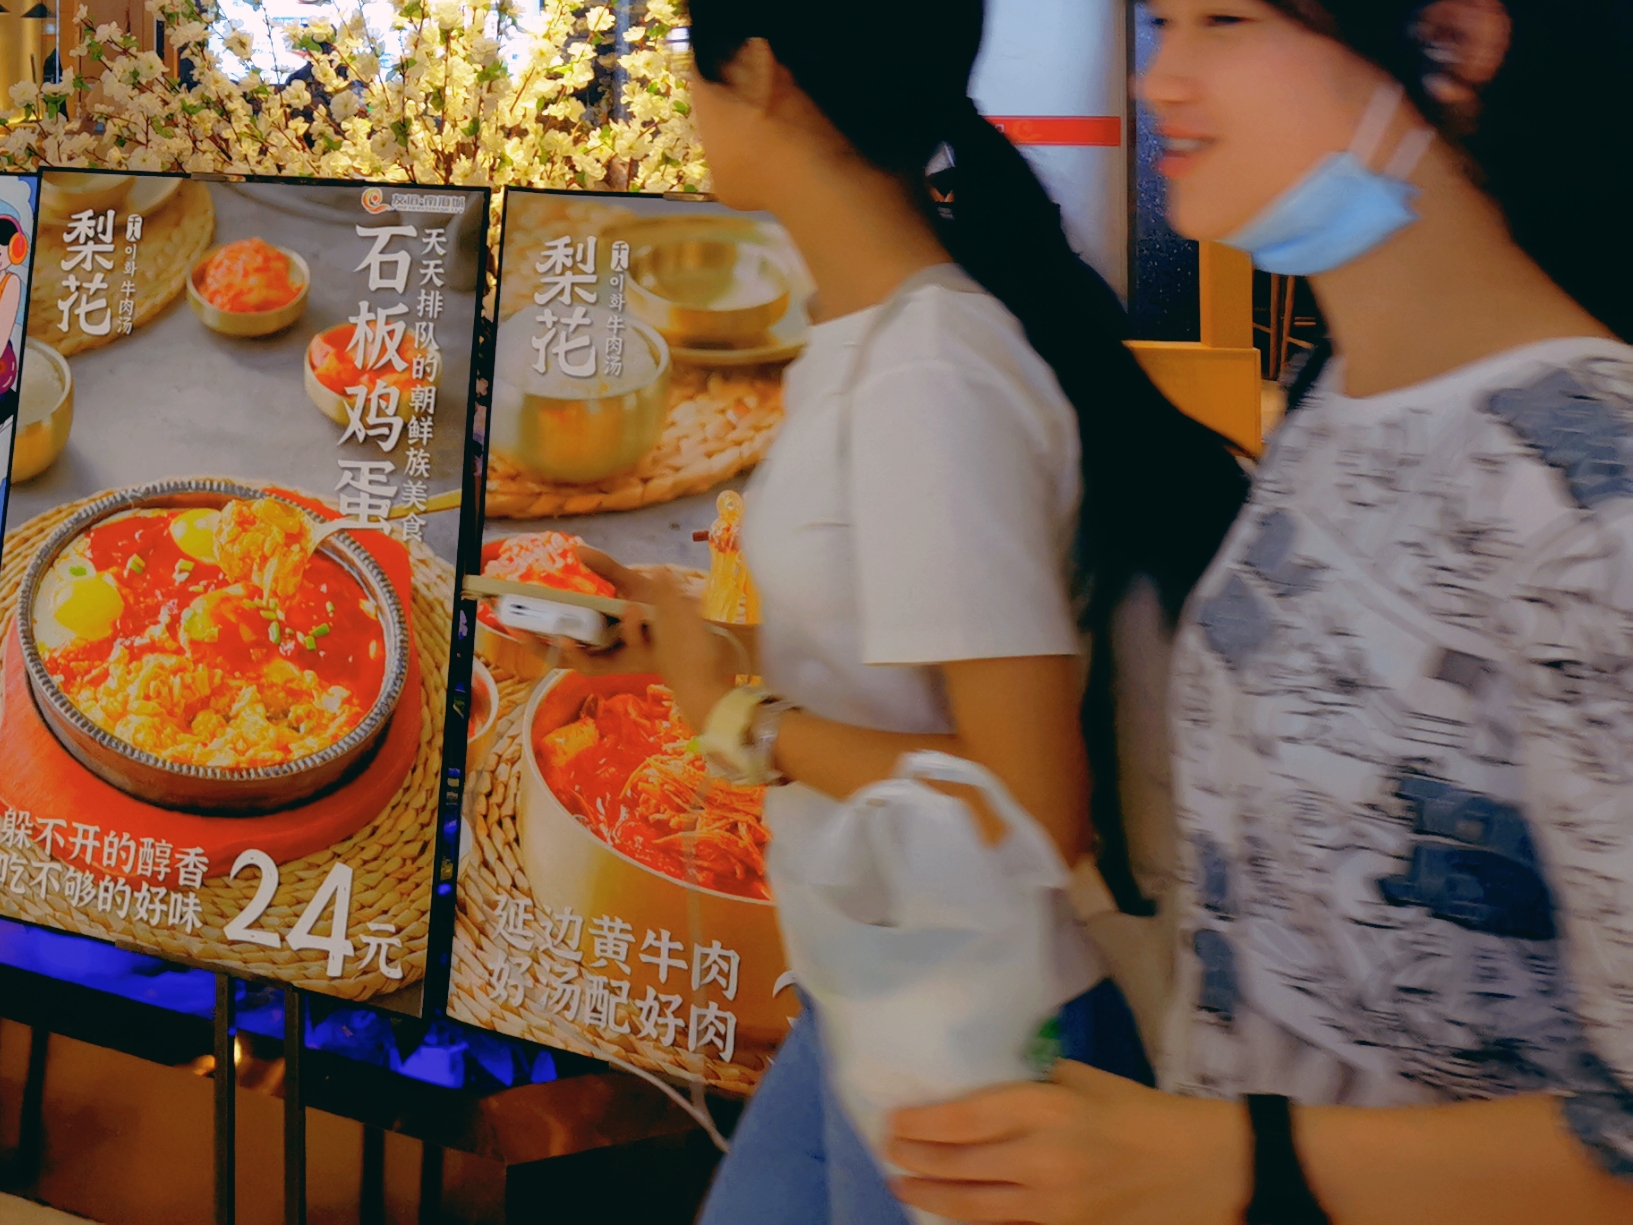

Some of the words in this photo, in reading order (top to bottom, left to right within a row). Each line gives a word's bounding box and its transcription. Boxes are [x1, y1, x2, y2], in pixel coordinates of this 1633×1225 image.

[57, 209, 116, 336] 梨花
[117, 280, 137, 335] 牛肉汤
[531, 235, 599, 378] 梨花
[334, 223, 418, 536] 石板鸡蛋
[400, 227, 448, 543] 天天排队的朝鲜族美食
[604, 315, 626, 376] 牛肉汤
[0, 805, 210, 891] 躲不开的醇香
[223, 848, 404, 980] 24元
[490, 893, 741, 1002] 延边黄牛肉
[487, 951, 738, 1064] 好汤配好肉
